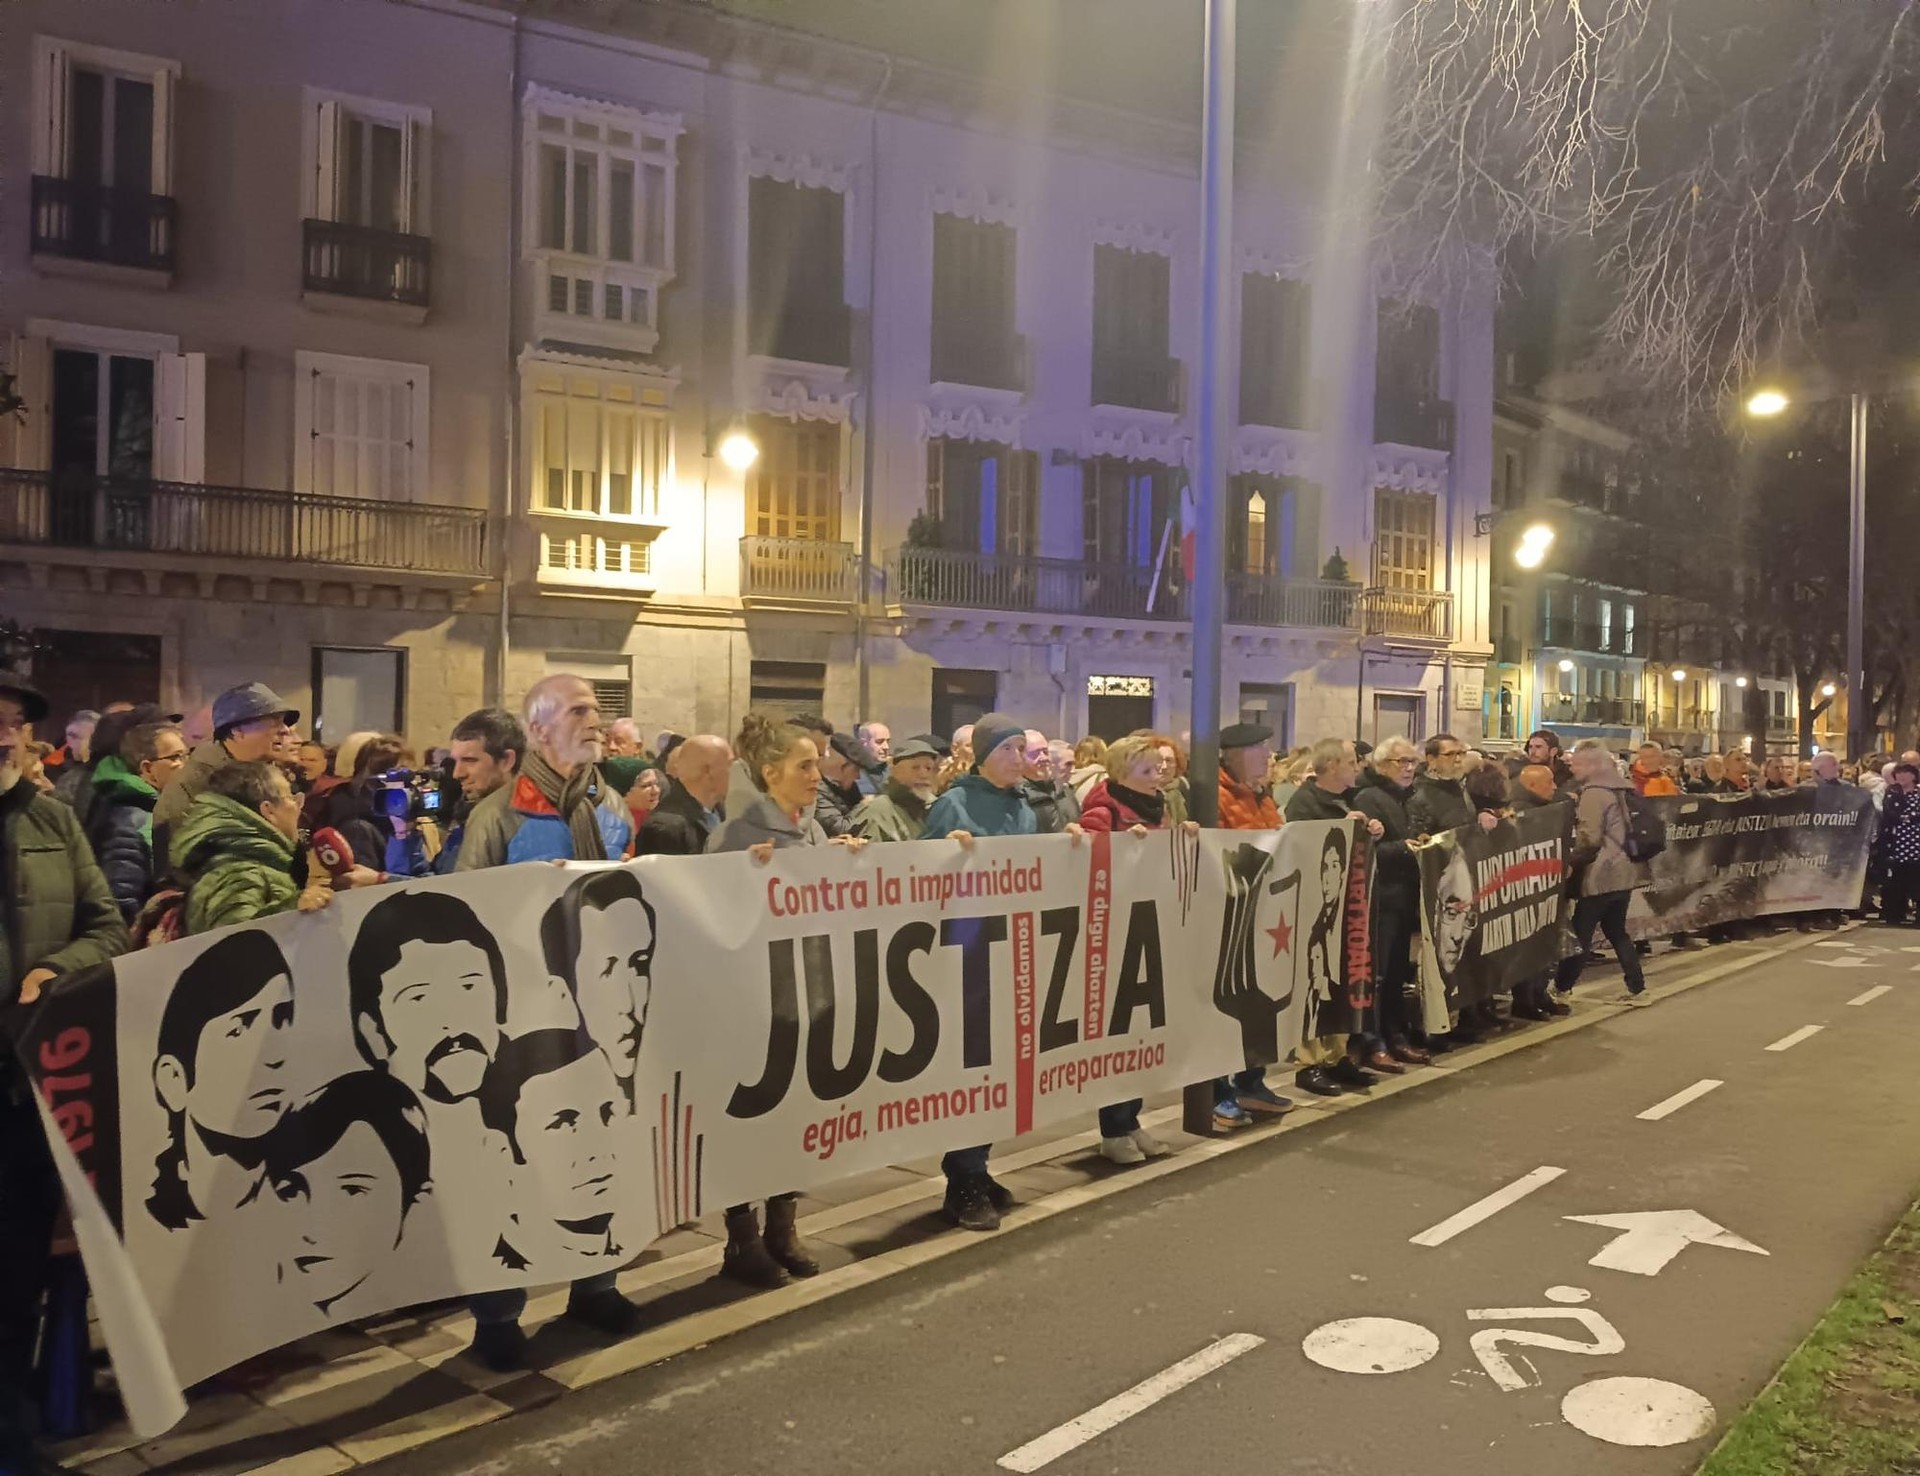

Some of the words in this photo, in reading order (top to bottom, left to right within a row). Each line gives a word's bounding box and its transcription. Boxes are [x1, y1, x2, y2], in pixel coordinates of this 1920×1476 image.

[767, 876, 868, 917] Contra
[876, 867, 902, 906] la
[910, 856, 1043, 910] impunidad
[1094, 869, 1107, 891] ez
[1348, 841, 1372, 985] MARTXOAK
[1088, 896, 1109, 948] dugu
[1016, 916, 1031, 1027] olvidamos
[1087, 953, 1106, 1036] ahazten
[1020, 1032, 1032, 1060] no
[876, 1074, 1008, 1133] memoria
[1039, 1040, 1166, 1096] erreparazioa
